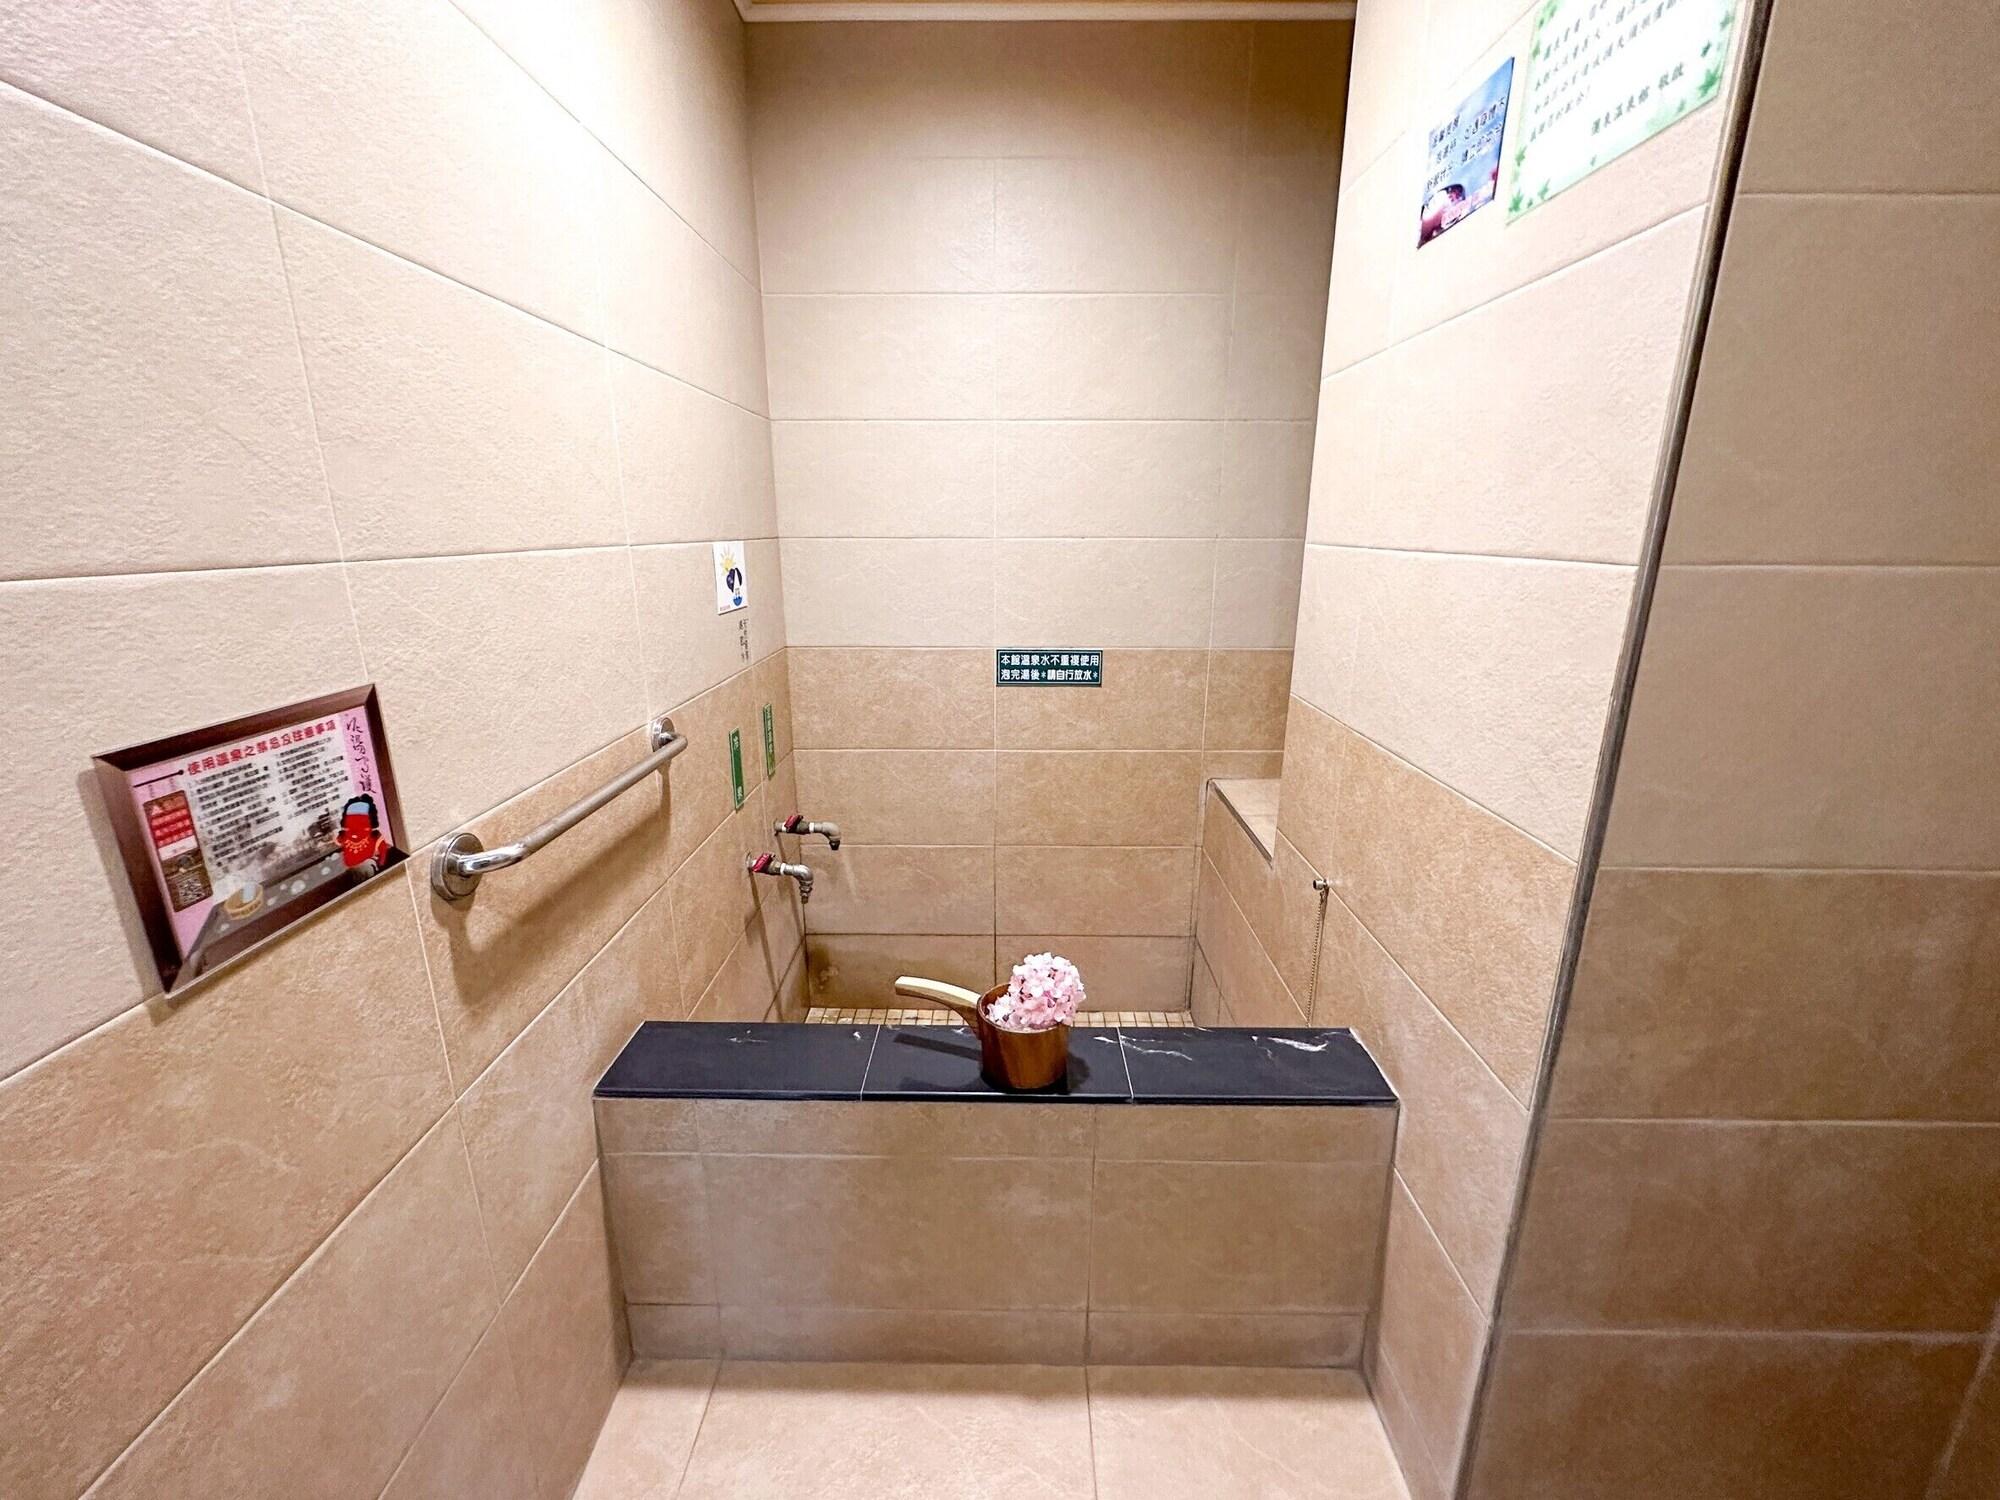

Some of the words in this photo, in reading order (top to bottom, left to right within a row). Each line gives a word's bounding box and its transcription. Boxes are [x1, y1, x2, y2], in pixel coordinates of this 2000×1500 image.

[1001, 654, 1099, 666] 本館溫泉水不重複使用
